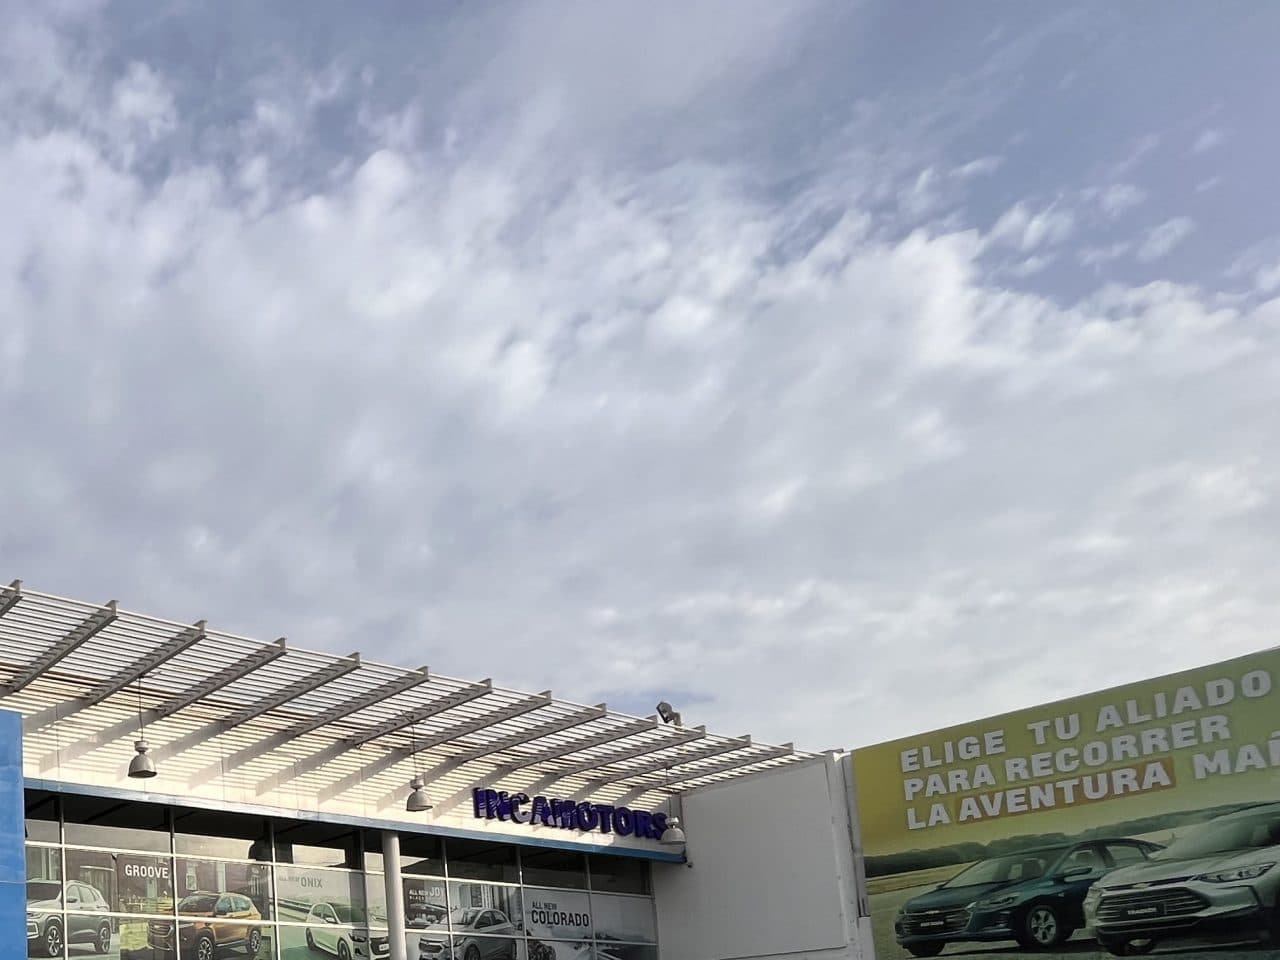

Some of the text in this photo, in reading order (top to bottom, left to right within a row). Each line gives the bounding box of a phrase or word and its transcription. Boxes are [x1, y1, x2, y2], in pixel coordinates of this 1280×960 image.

[901, 669, 1272, 773] ELIGE TU ALIADO
[904, 714, 1231, 801] PARA RECORRER
[906, 803, 950, 830] LA
[959, 761, 1171, 822] AVENTURA
[473, 787, 669, 841] INCAMOTORS
[124, 864, 169, 880] GROOVE
[300, 876, 323, 888] ONIX
[531, 901, 542, 909] ALL
[531, 910, 590, 927] COLORADO
